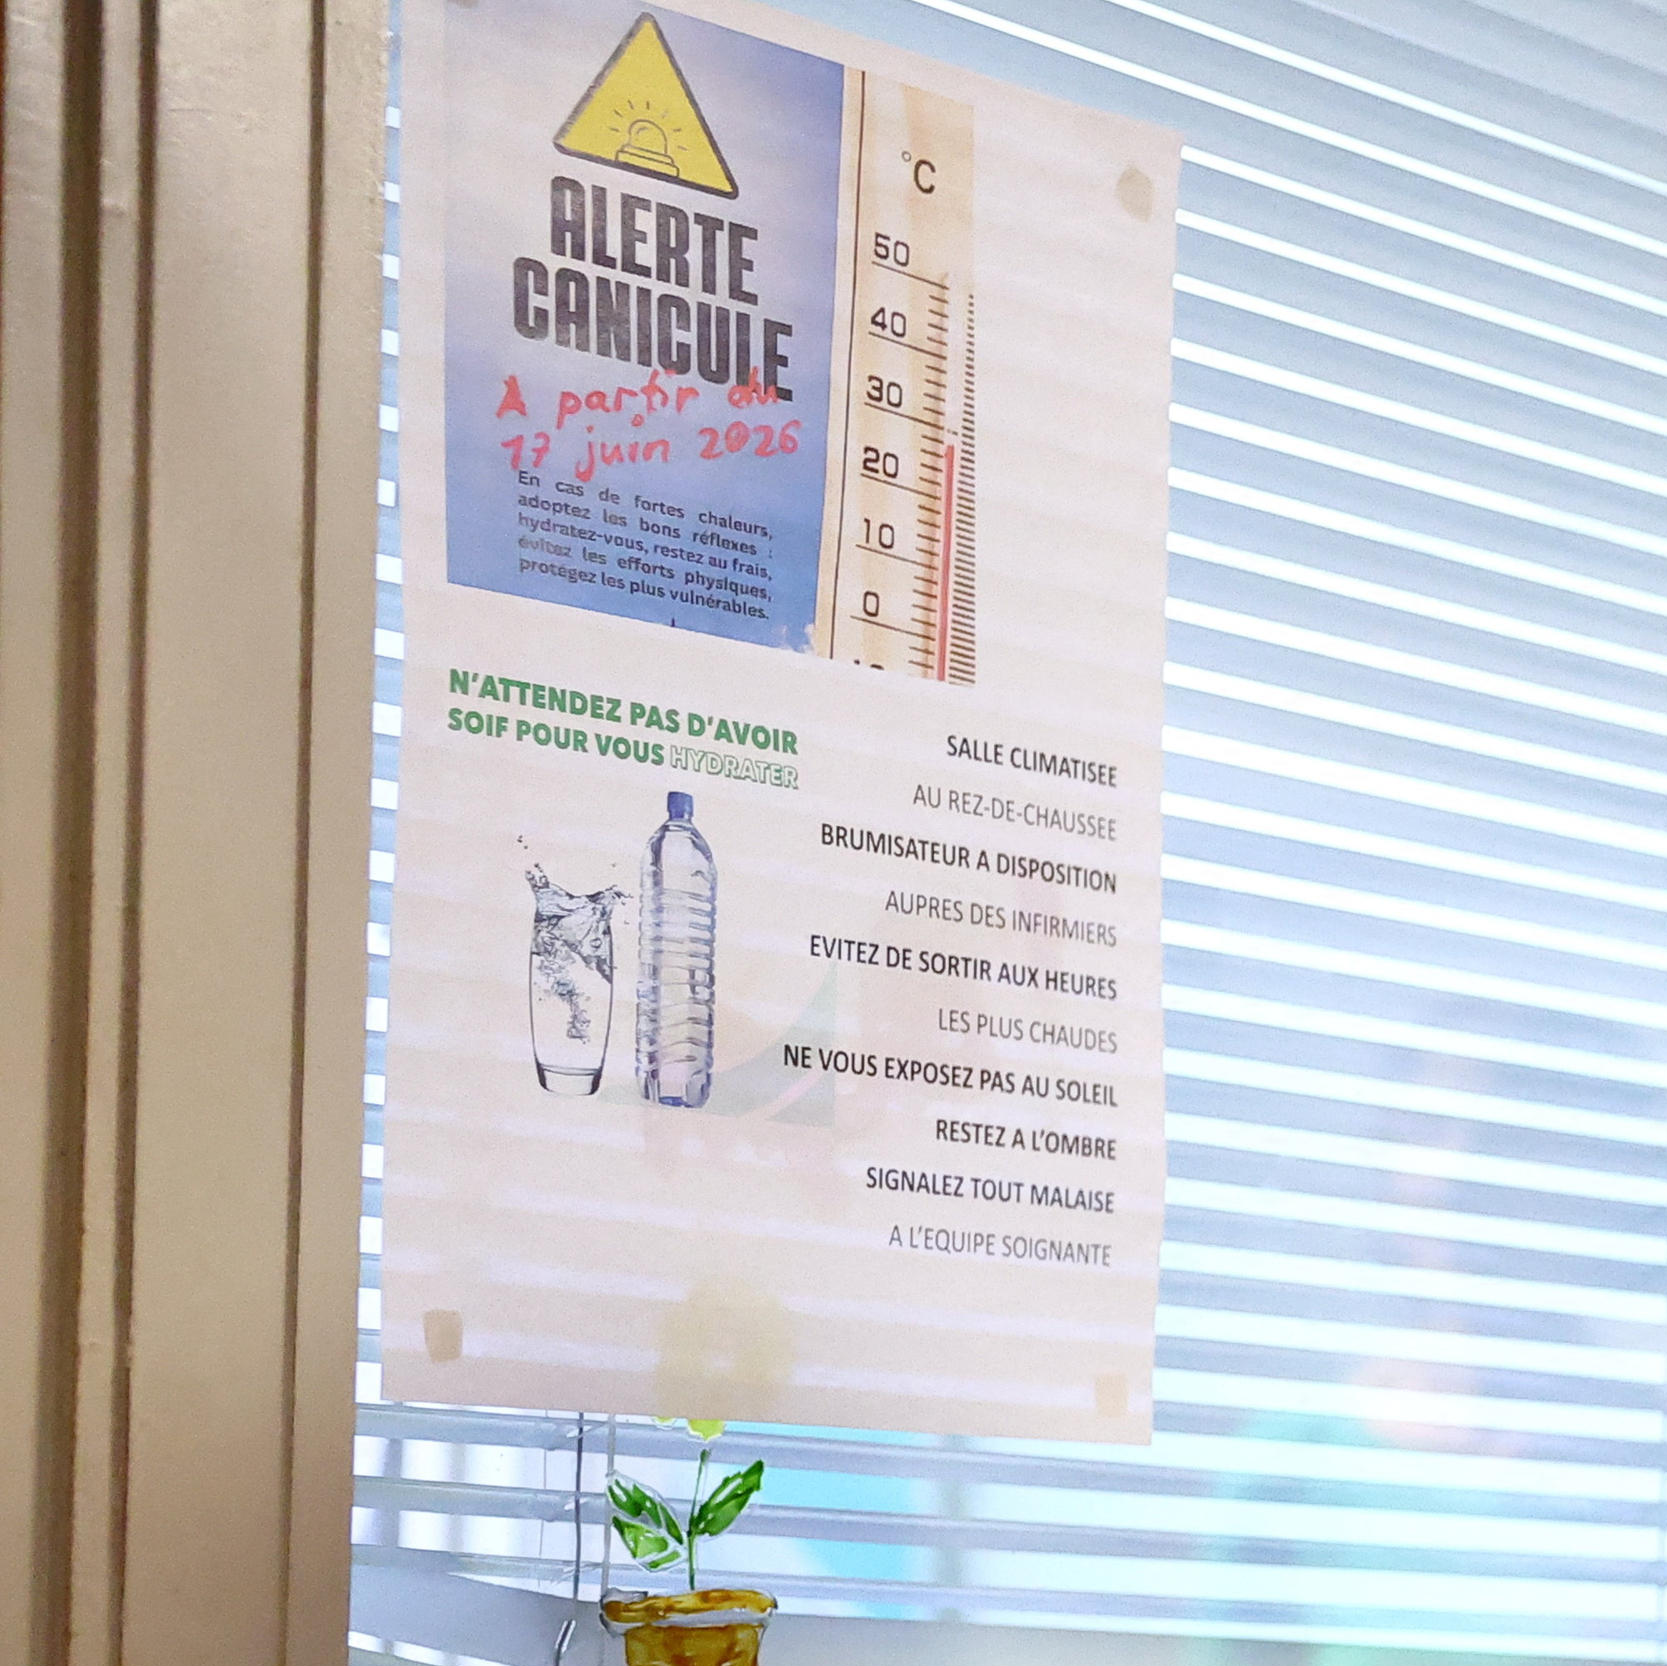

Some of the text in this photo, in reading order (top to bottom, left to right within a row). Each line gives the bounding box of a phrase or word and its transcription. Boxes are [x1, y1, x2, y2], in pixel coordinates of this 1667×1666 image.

[550, 176, 758, 306] ALERTE
[874, 232, 910, 267] 50
[513, 257, 793, 401] CANICULE
[870, 306, 907, 338] 40
[496, 366, 781, 430] A partir du
[866, 375, 902, 408] 30
[501, 414, 802, 482] 17 juin 2026
[862, 446, 899, 479] 20
[518, 470, 773, 541] En cas de fortes chaleurs,
[518, 493, 591, 520] adoptez
[603, 509, 627, 528] les
[640, 517, 681, 539] bons
[692, 530, 757, 556] réflexes
[863, 518, 894, 549] 10
[518, 512, 772, 582] hydratez-vous, restez au frais,
[582, 546, 607, 565] les
[617, 555, 675, 579] efforts
[684, 569, 772, 602] physiques,
[520, 557, 769, 620] protégez les plus vulnérables.
[863, 591, 880, 618] 0
[449, 668, 798, 754] N'ATTENDEZ PAS D'AVOIR
[448, 708, 799, 789] SOIF POUR VOUS HYDRATER
[947, 735, 1117, 788] SALLE CLIMATISEE
[913, 784, 1117, 841] AU REZ-DE-CHAUSSEE
[821, 823, 1117, 894] BRUMISATEUR A DISPOSITION
[885, 890, 1117, 948] AUPRES DES INFIRMIERS
[810, 934, 1117, 1001] EVITEZ DE SORTIR AUX HEURES
[938, 1008, 1118, 1054] LES PLUS CHAUDES
[784, 1044, 1118, 1107] NE VOUS EXPOSEZ PAS AU SOLEIL
[936, 1119, 1117, 1160] RESTEZ A L'OMBRE
[866, 1167, 1115, 1214] SIGNALEZ TOUT MALAISE
[889, 1225, 1112, 1267] A L'EQUIPE SOIGNANTE
